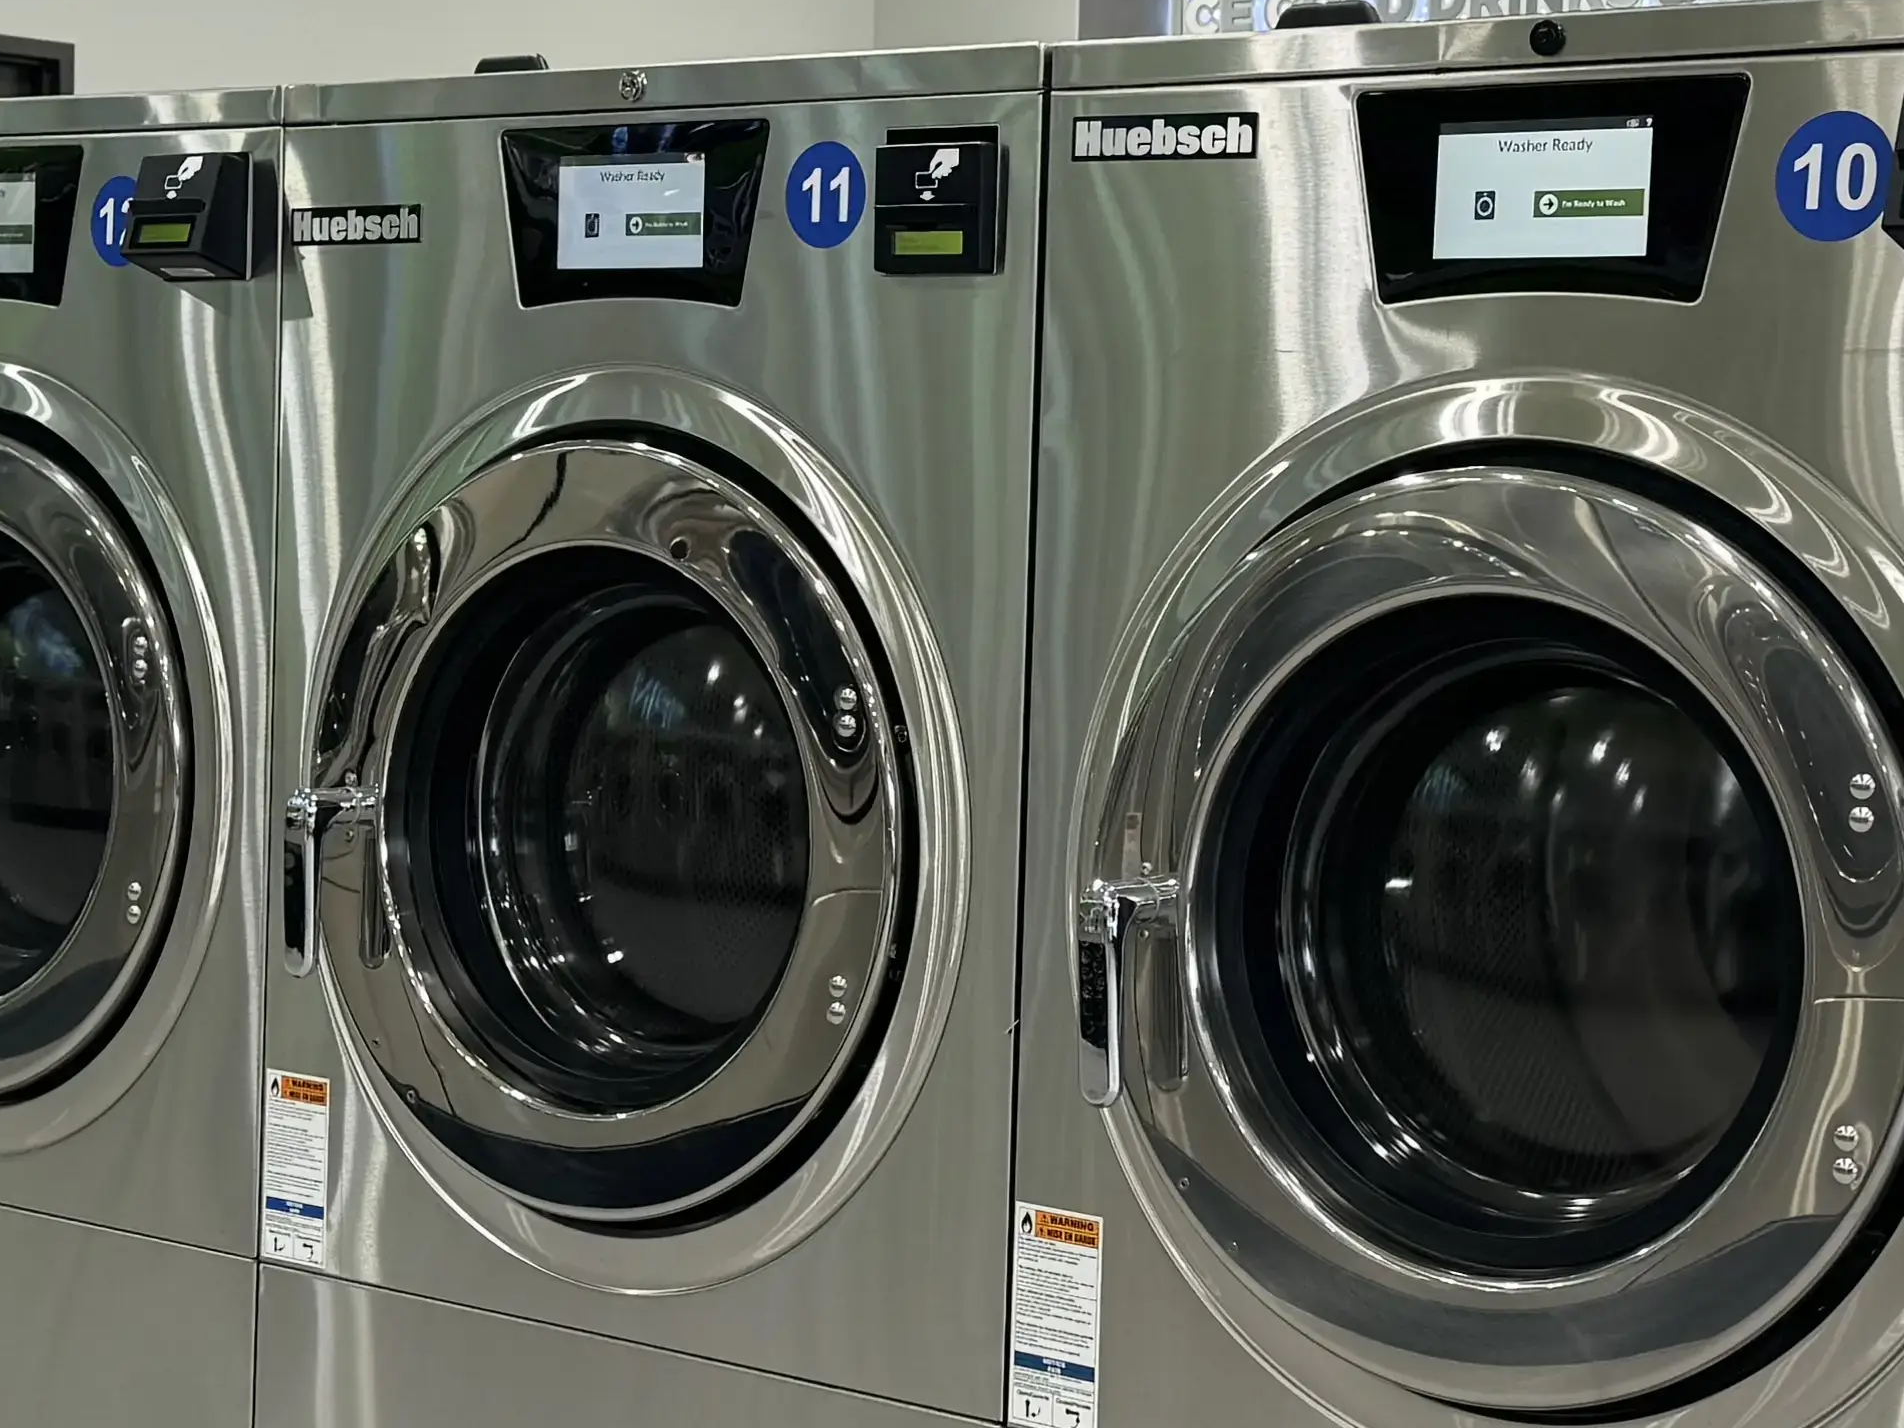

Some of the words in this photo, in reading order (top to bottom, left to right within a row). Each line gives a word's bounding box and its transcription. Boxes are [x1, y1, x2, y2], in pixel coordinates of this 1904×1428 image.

[1074, 116, 1253, 157] Huebsch
[1498, 139, 1547, 153] Washer
[1552, 137, 1593, 153] Ready
[802, 166, 850, 223] 11
[1793, 142, 1878, 211] 10
[293, 207, 418, 242] Huebsch
